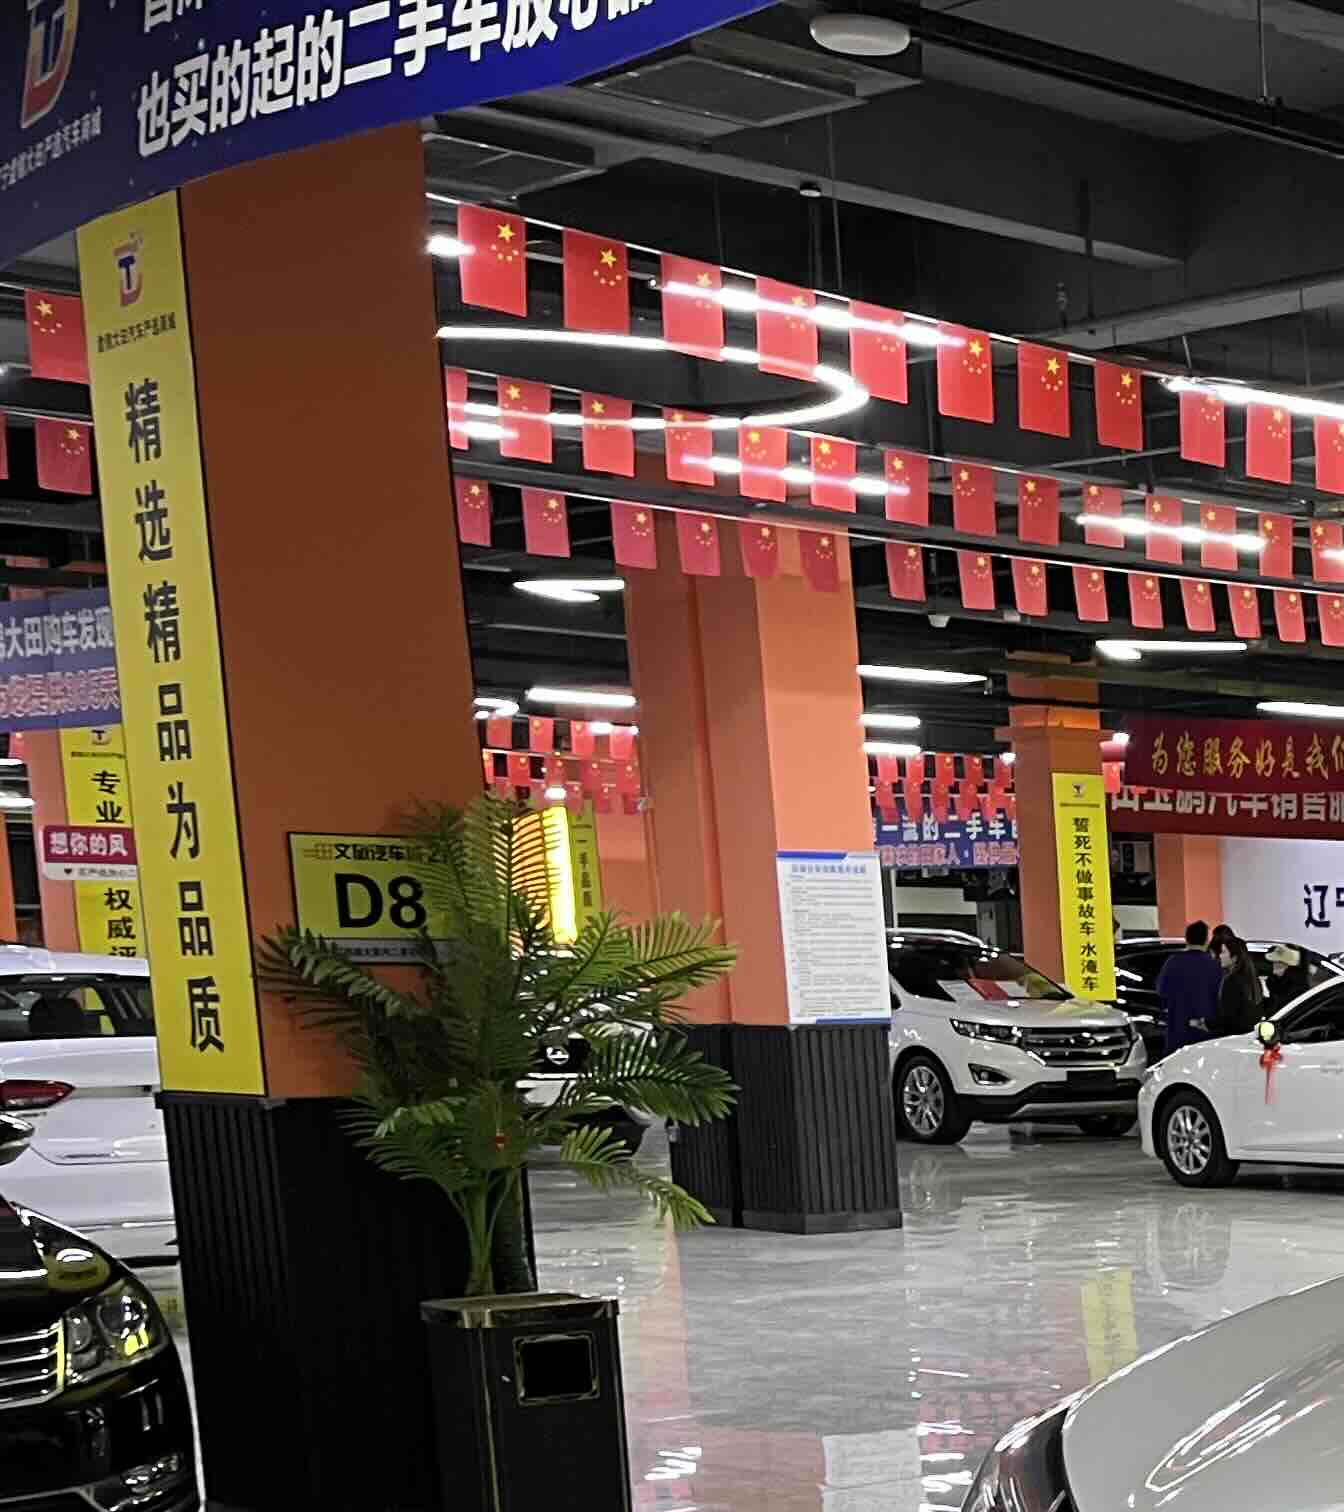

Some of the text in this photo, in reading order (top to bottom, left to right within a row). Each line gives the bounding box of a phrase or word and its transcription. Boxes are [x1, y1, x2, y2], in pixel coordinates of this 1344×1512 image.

[0, 606, 114, 660] 大田购车发现
[124, 378, 224, 1054] 精选精品为品质
[872, 811, 1018, 841] 一流的二手车
[335, 873, 427, 928] D8
